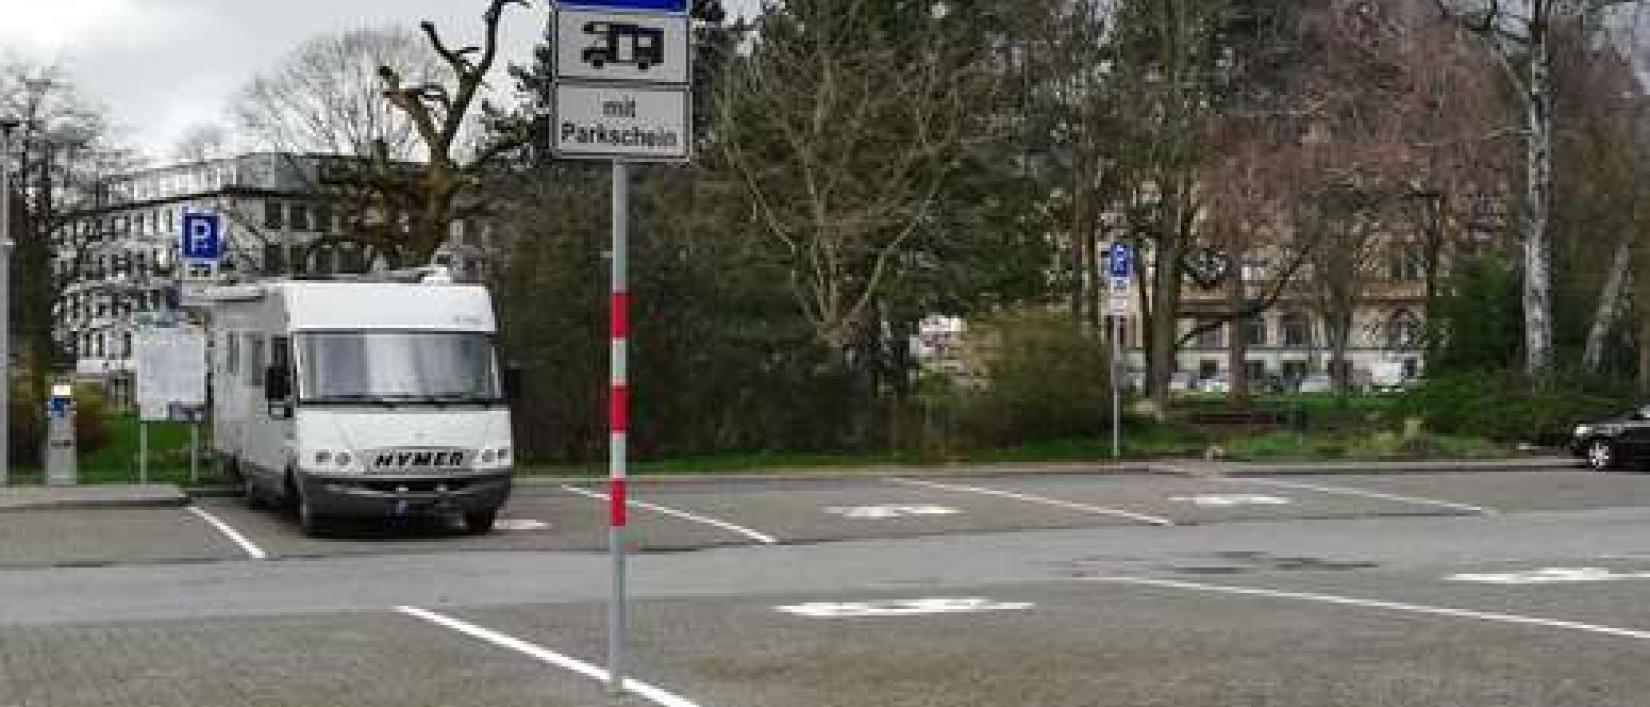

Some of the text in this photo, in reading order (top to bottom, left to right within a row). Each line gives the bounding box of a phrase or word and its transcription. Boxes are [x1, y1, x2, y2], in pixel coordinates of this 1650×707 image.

[602, 96, 636, 118] mit
[561, 122, 678, 147] Parkschein
[191, 218, 212, 252] P
[375, 451, 464, 466] HYMER
